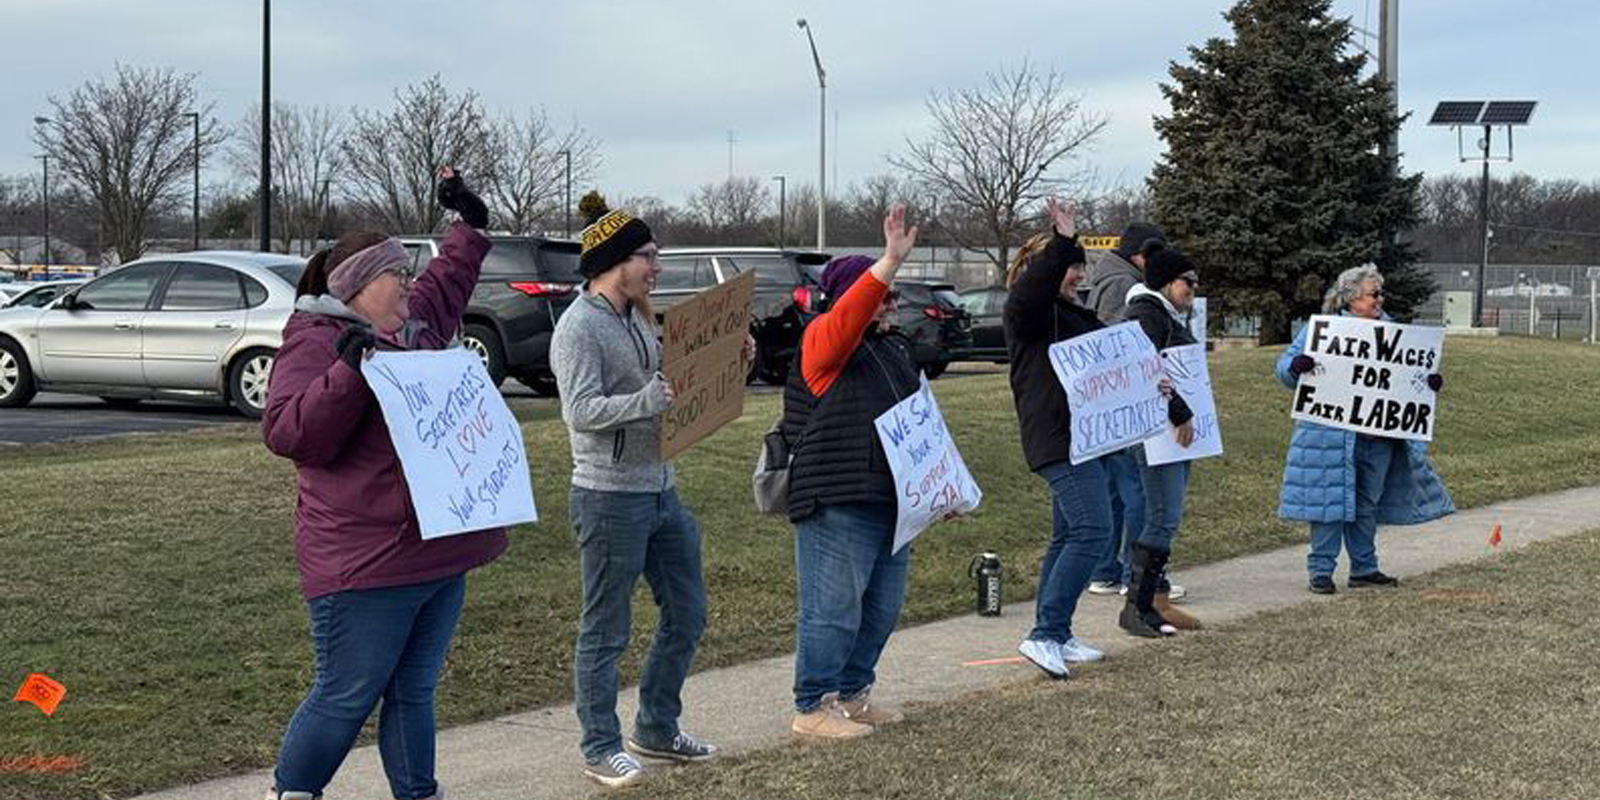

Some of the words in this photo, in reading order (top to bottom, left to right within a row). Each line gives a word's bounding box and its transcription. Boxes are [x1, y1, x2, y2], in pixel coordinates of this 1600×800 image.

[1052, 338, 1107, 377] HONK
[1108, 330, 1128, 358] IF
[1310, 321, 1371, 360] FAIR
[1073, 364, 1131, 409] SUPPORT
[1351, 365, 1391, 390] FOR
[416, 364, 486, 449] SECRETARIES
[1076, 396, 1167, 453] SECRETARIES
[1295, 385, 1345, 422] FAIR
[1349, 396, 1431, 435] LABOR
